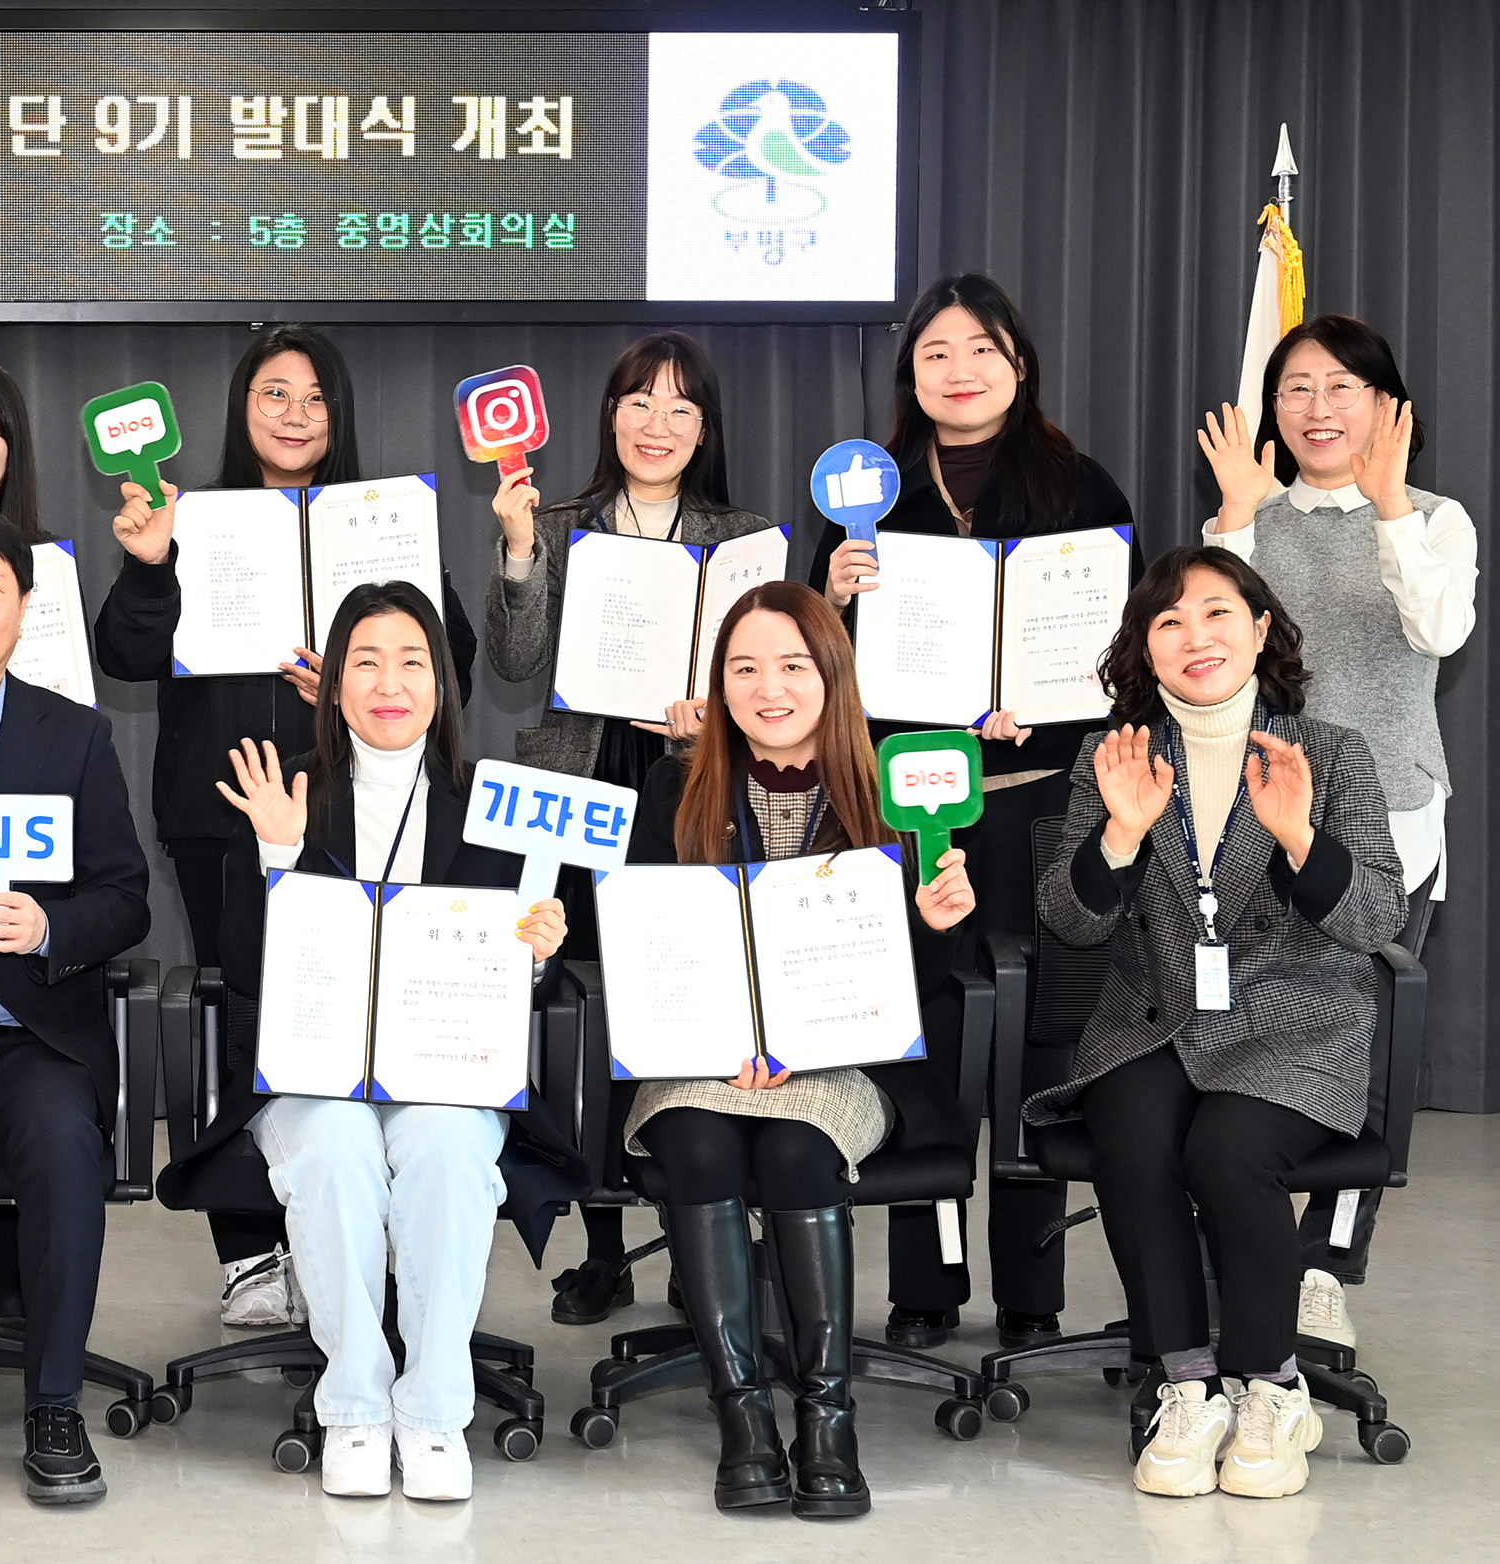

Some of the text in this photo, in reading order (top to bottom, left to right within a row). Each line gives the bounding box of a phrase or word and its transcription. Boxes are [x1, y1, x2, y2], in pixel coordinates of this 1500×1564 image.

[94, 95, 193, 160] 9기
[230, 95, 417, 160] 발대식
[451, 96, 574, 160] 개최
[100, 212, 178, 249] 장소
[249, 213, 308, 249] 5층
[336, 212, 577, 250] 중영상회의실
[723, 229, 818, 265] 부평구
[107, 415, 154, 439] blog
[904, 769, 957, 789] blog
[482, 779, 628, 848] 기자단
